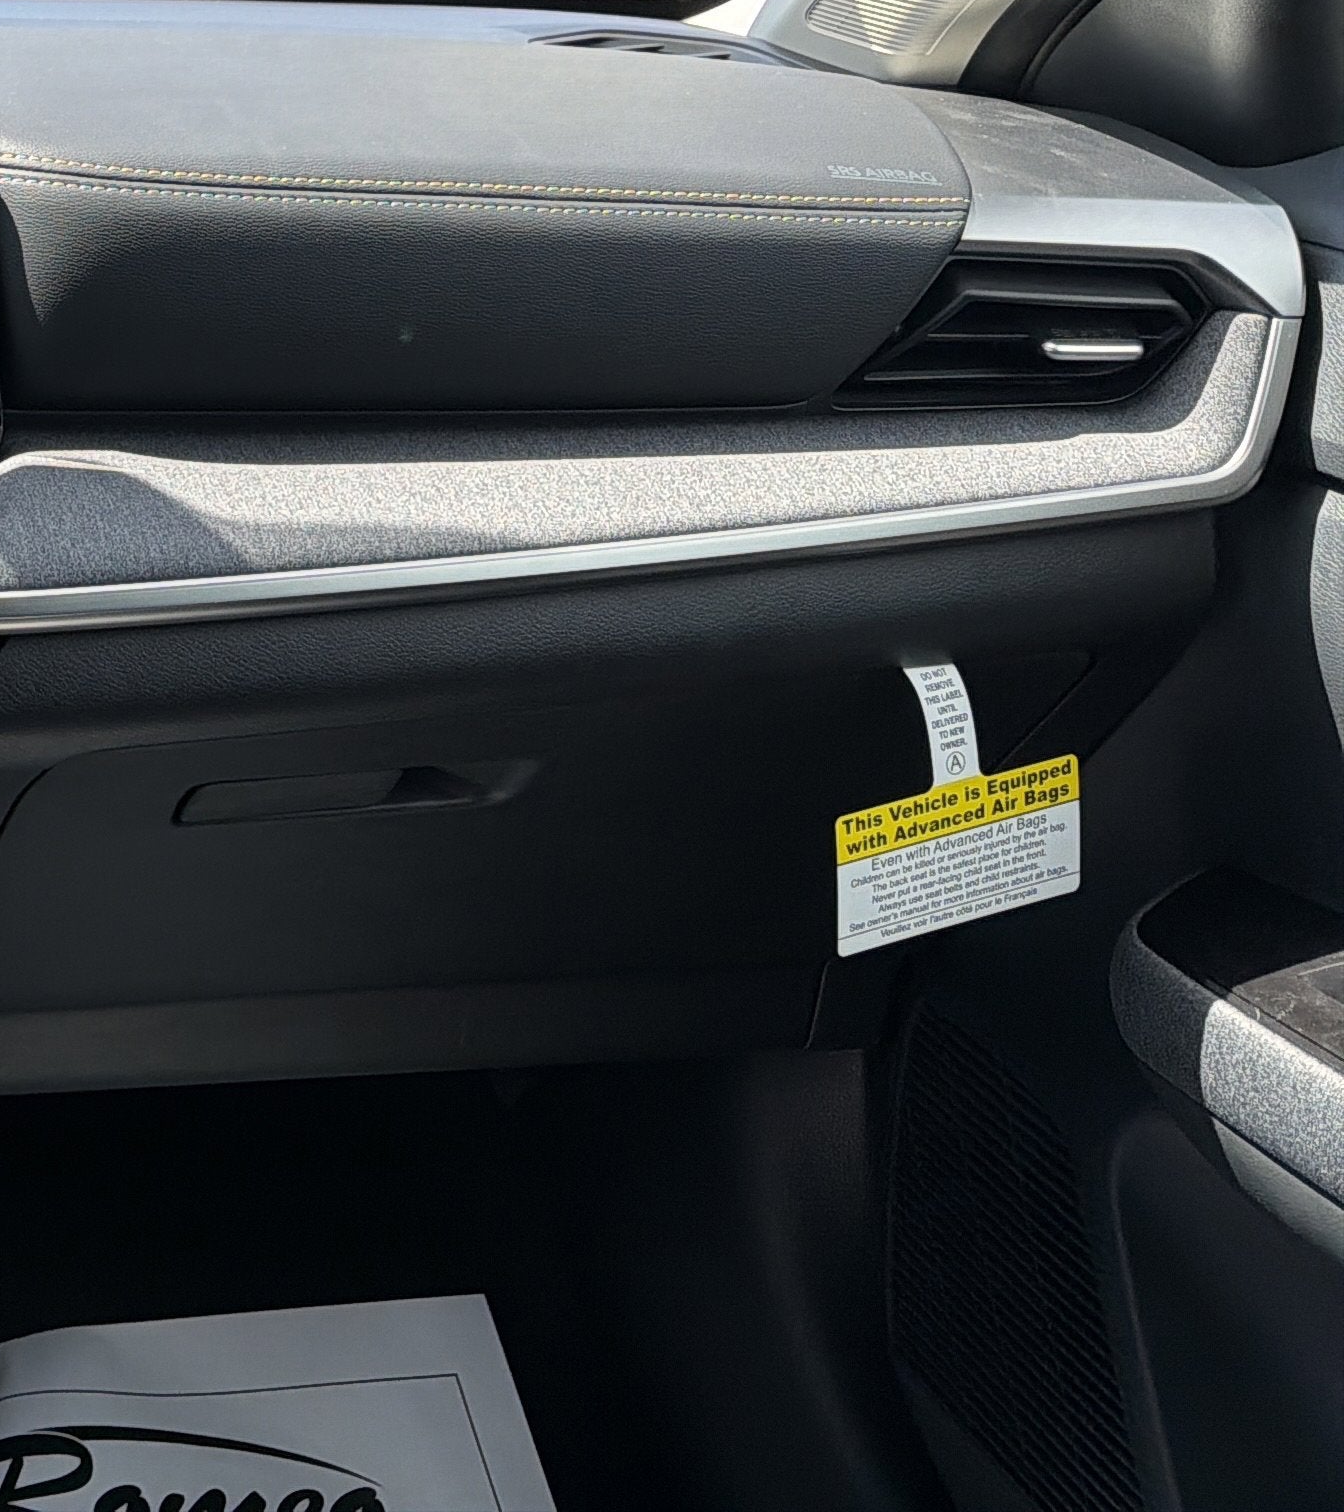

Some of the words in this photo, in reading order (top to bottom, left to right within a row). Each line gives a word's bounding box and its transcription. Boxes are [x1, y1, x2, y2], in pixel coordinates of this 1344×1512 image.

[827, 165, 862, 177] SRS
[865, 167, 937, 183] AIRBAG
[919, 671, 932, 682] DO
[932, 668, 948, 679] NOT
[924, 678, 955, 693] REMOVE
[924, 694, 941, 706] THIS
[941, 689, 964, 702] LABEL
[936, 703, 958, 716] UNTIL
[931, 713, 969, 729] DELIVERED
[939, 731, 949, 740] TO
[949, 726, 966, 737] NEW
[940, 738, 968, 752] OWNER.
[950, 754, 963, 771] A
[842, 813, 883, 835] This
[889, 792, 959, 822] Vehicle
[964, 786, 981, 803] is
[986, 759, 1072, 797] Equipped
[845, 832, 888, 856] with
[893, 803, 985, 843] Advanced
[992, 796, 1019, 816] Air
[1023, 783, 1070, 807] Bags
[871, 853, 903, 872] Even
[905, 844, 930, 863] with
[933, 829, 993, 855] Advanced
[995, 822, 1014, 837] Air
[1016, 814, 1047, 831] Bags
[850, 871, 884, 889] Children
[885, 868, 901, 879] can
[902, 864, 913, 874] be
[914, 857, 936, 871] killed
[936, 855, 946, 864] or
[947, 844, 982, 861] seriously
[983, 835, 1011, 852] injured
[1012, 834, 1023, 845] by
[1023, 829, 1037, 839] the
[1037, 825, 1049, 836] air
[872, 882, 888, 894] The
[889, 876, 909, 888] back
[910, 870, 928, 882] seat
[928, 867, 937, 877] is
[938, 863, 951, 874] the
[952, 856, 977, 871] safest
[977, 850, 1000, 866] place
[1000, 847, 1013, 858] for
[848, 921, 866, 933] See
[866, 912, 899, 929] owner's
[899, 902, 930, 919] manual
[931, 899, 943, 910] for
[943, 893, 964, 906] more
[965, 880, 1010, 898] information
[1010, 874, 1034, 888] about
[1034, 869, 1046, 880] air
